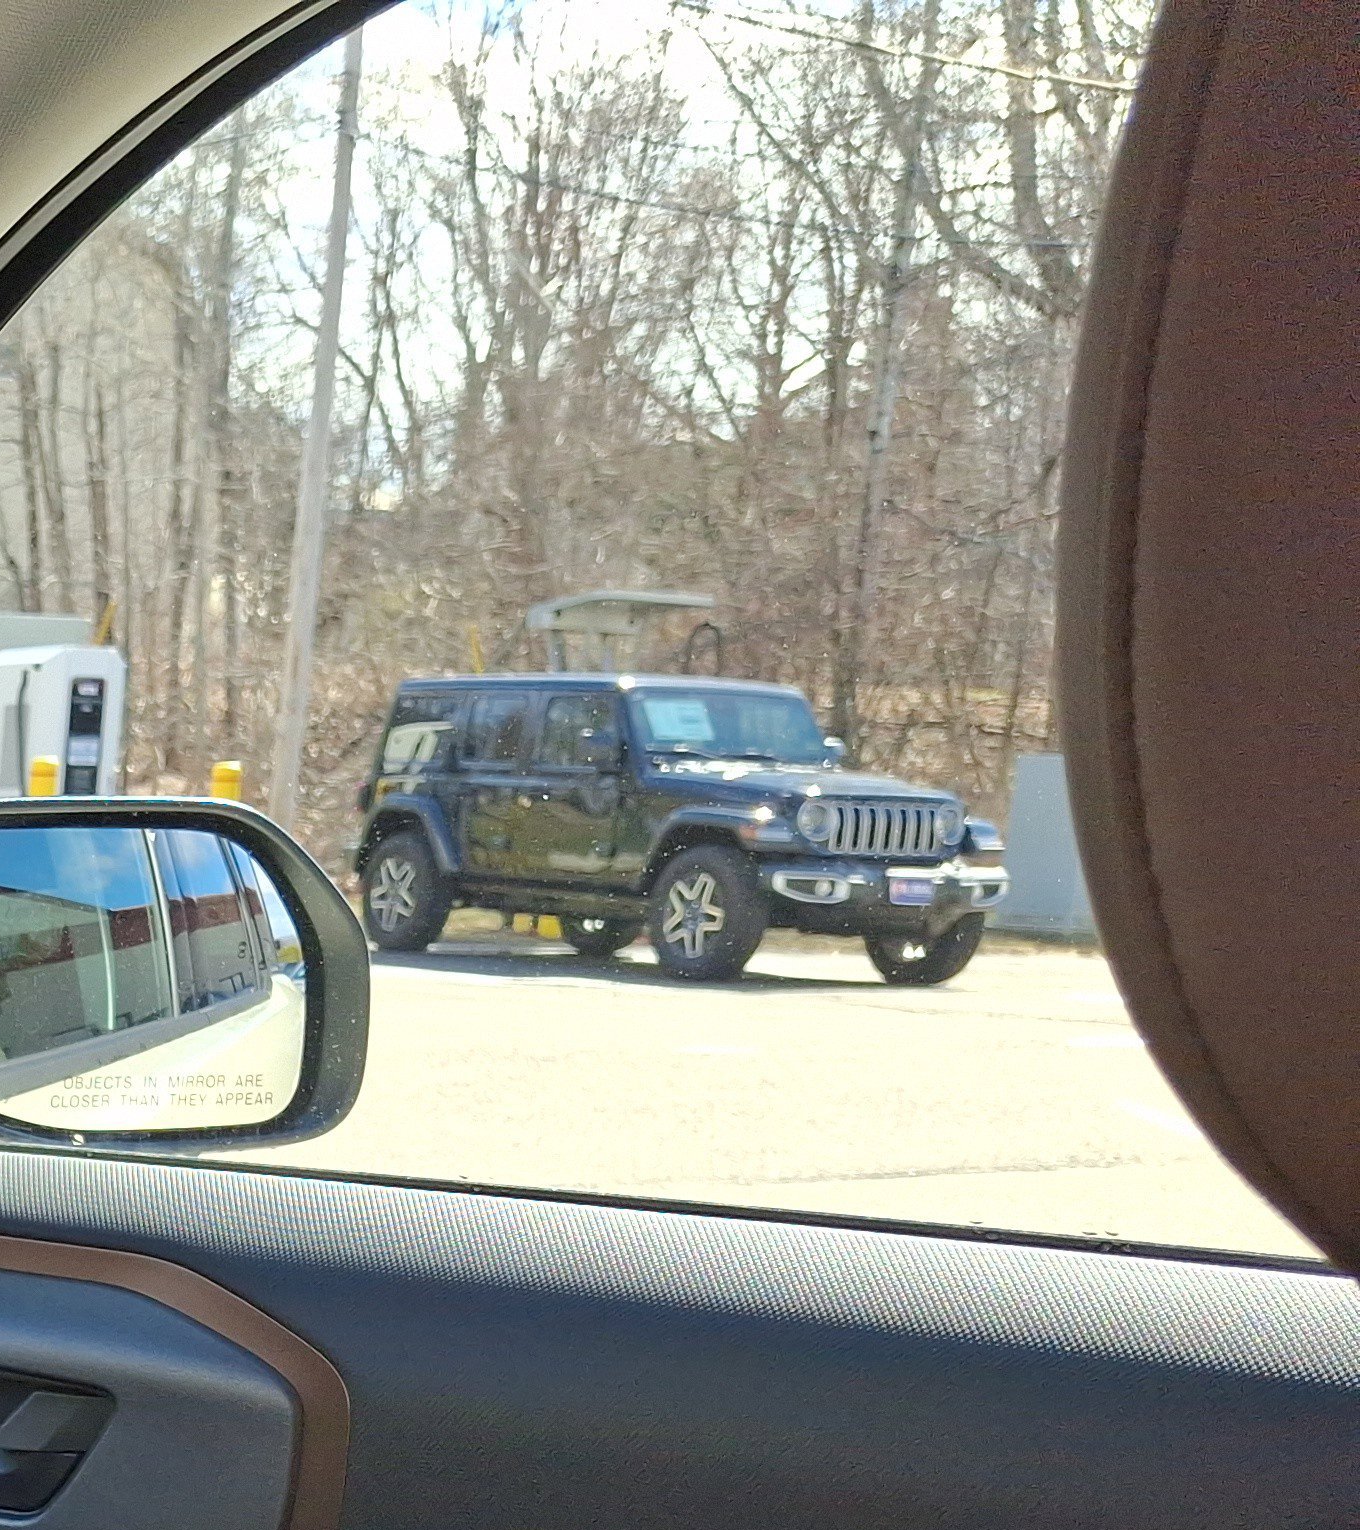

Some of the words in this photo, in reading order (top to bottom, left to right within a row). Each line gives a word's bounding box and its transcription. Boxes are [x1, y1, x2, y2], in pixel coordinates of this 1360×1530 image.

[63, 1075, 132, 1090] OBJECTS
[143, 1075, 157, 1089] IN
[168, 1074, 225, 1088] MIRROR
[235, 1073, 264, 1087] ARE
[50, 1094, 110, 1108] CLOSER
[120, 1093, 159, 1107] THAN
[171, 1092, 207, 1106] THEY
[216, 1091, 274, 1106] APPEAR
